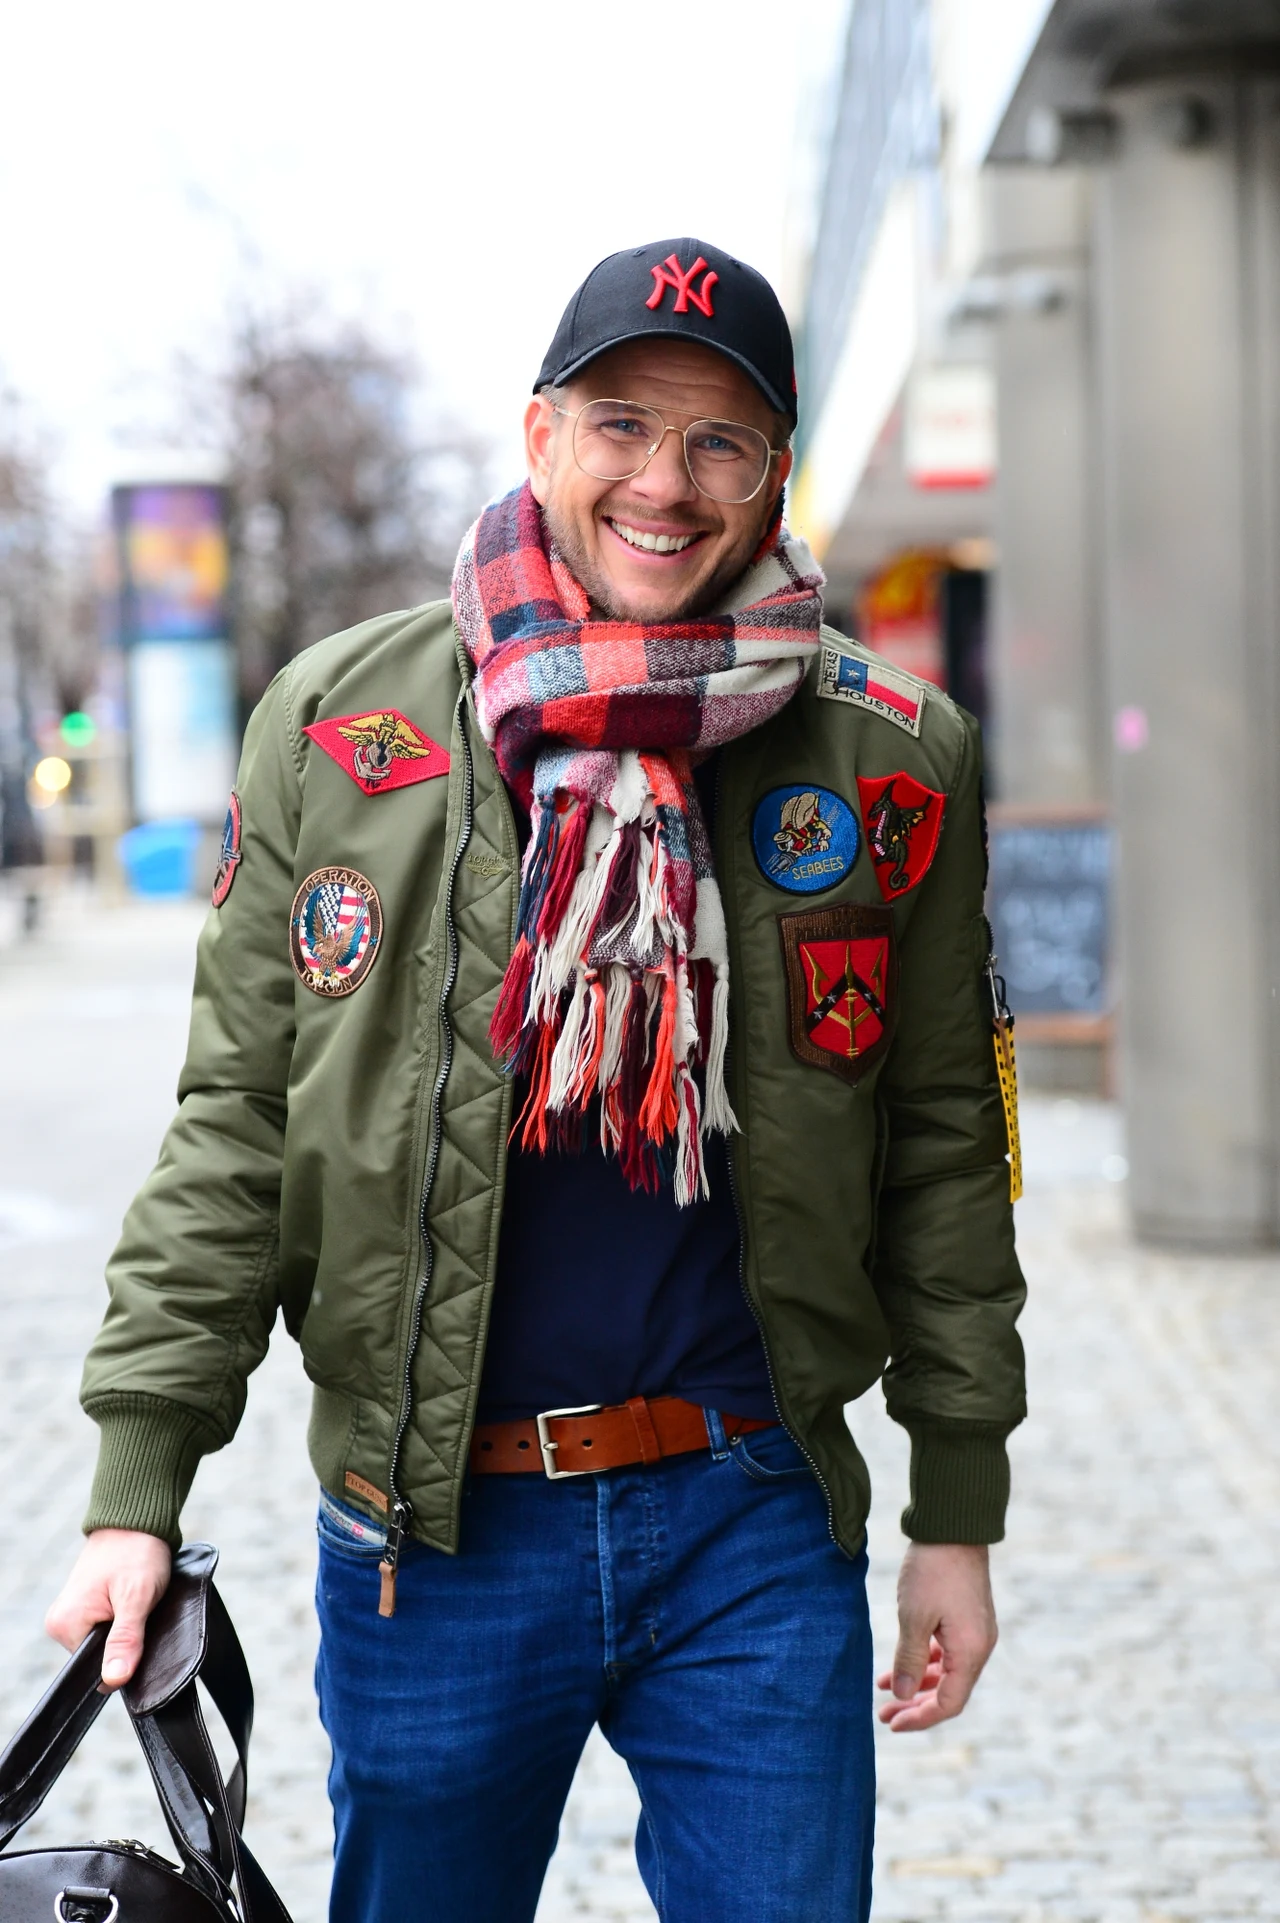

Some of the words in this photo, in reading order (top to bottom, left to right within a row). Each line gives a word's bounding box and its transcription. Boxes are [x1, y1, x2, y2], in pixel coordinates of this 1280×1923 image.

[645, 253, 719, 318] NY
[824, 651, 838, 684] TEXAS
[835, 688, 915, 730] HOUSTON
[791, 855, 844, 880] SEABEES
[305, 870, 375, 903] OPERATION
